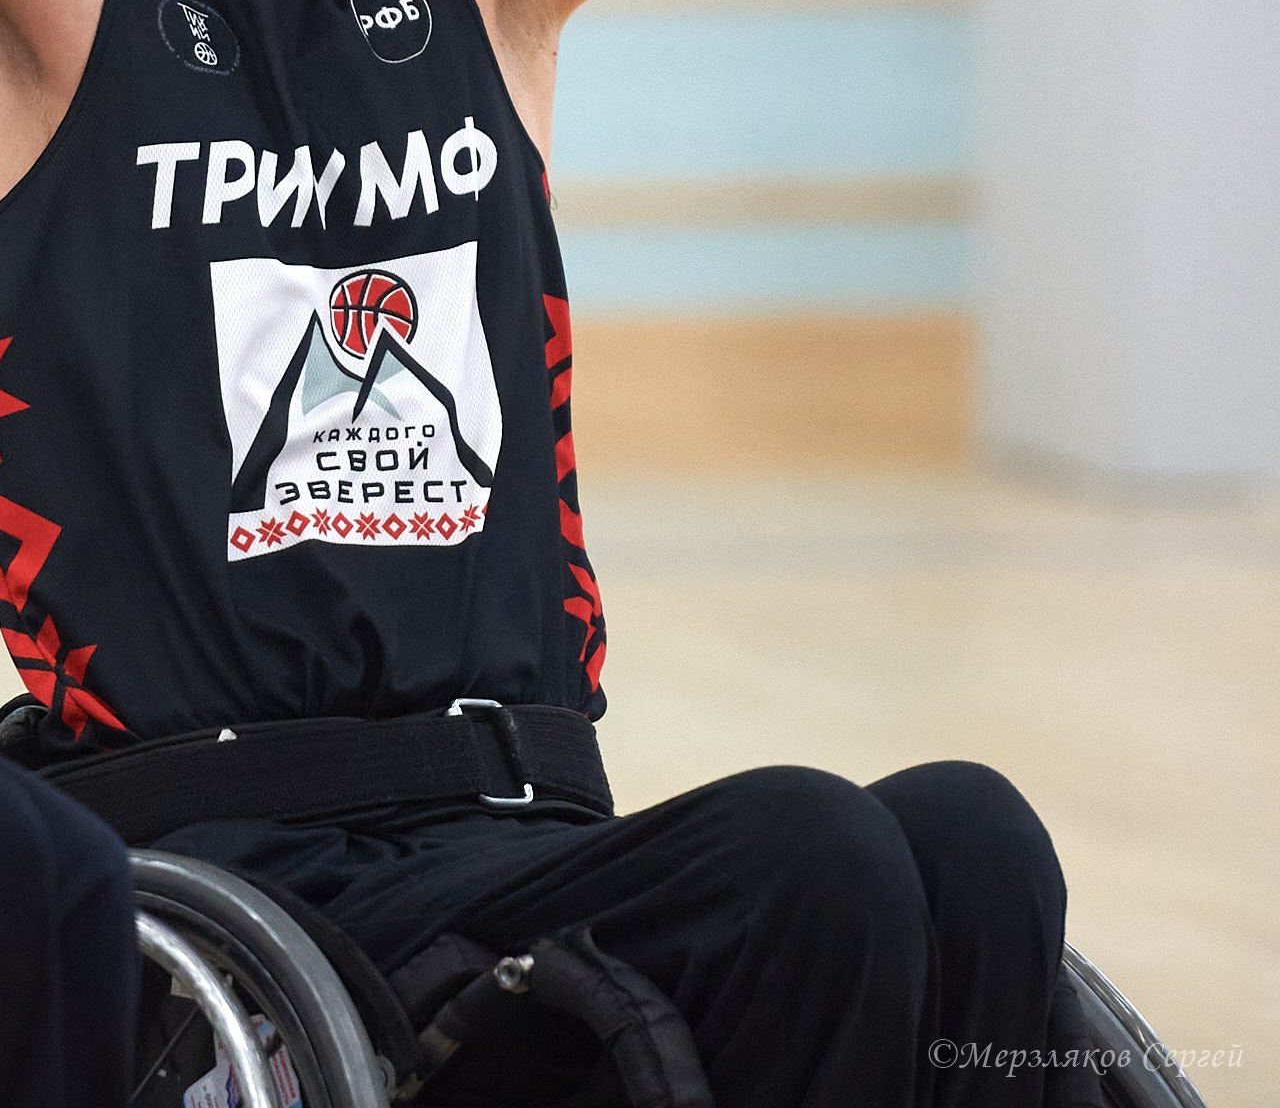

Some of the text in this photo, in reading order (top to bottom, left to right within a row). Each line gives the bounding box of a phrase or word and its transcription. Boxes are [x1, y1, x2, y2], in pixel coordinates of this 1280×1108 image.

[313, 424, 435, 444] КАЖДОГО
[316, 441, 429, 472] СВОЙ
[275, 480, 468, 505] ЭВЕРЕСТ
